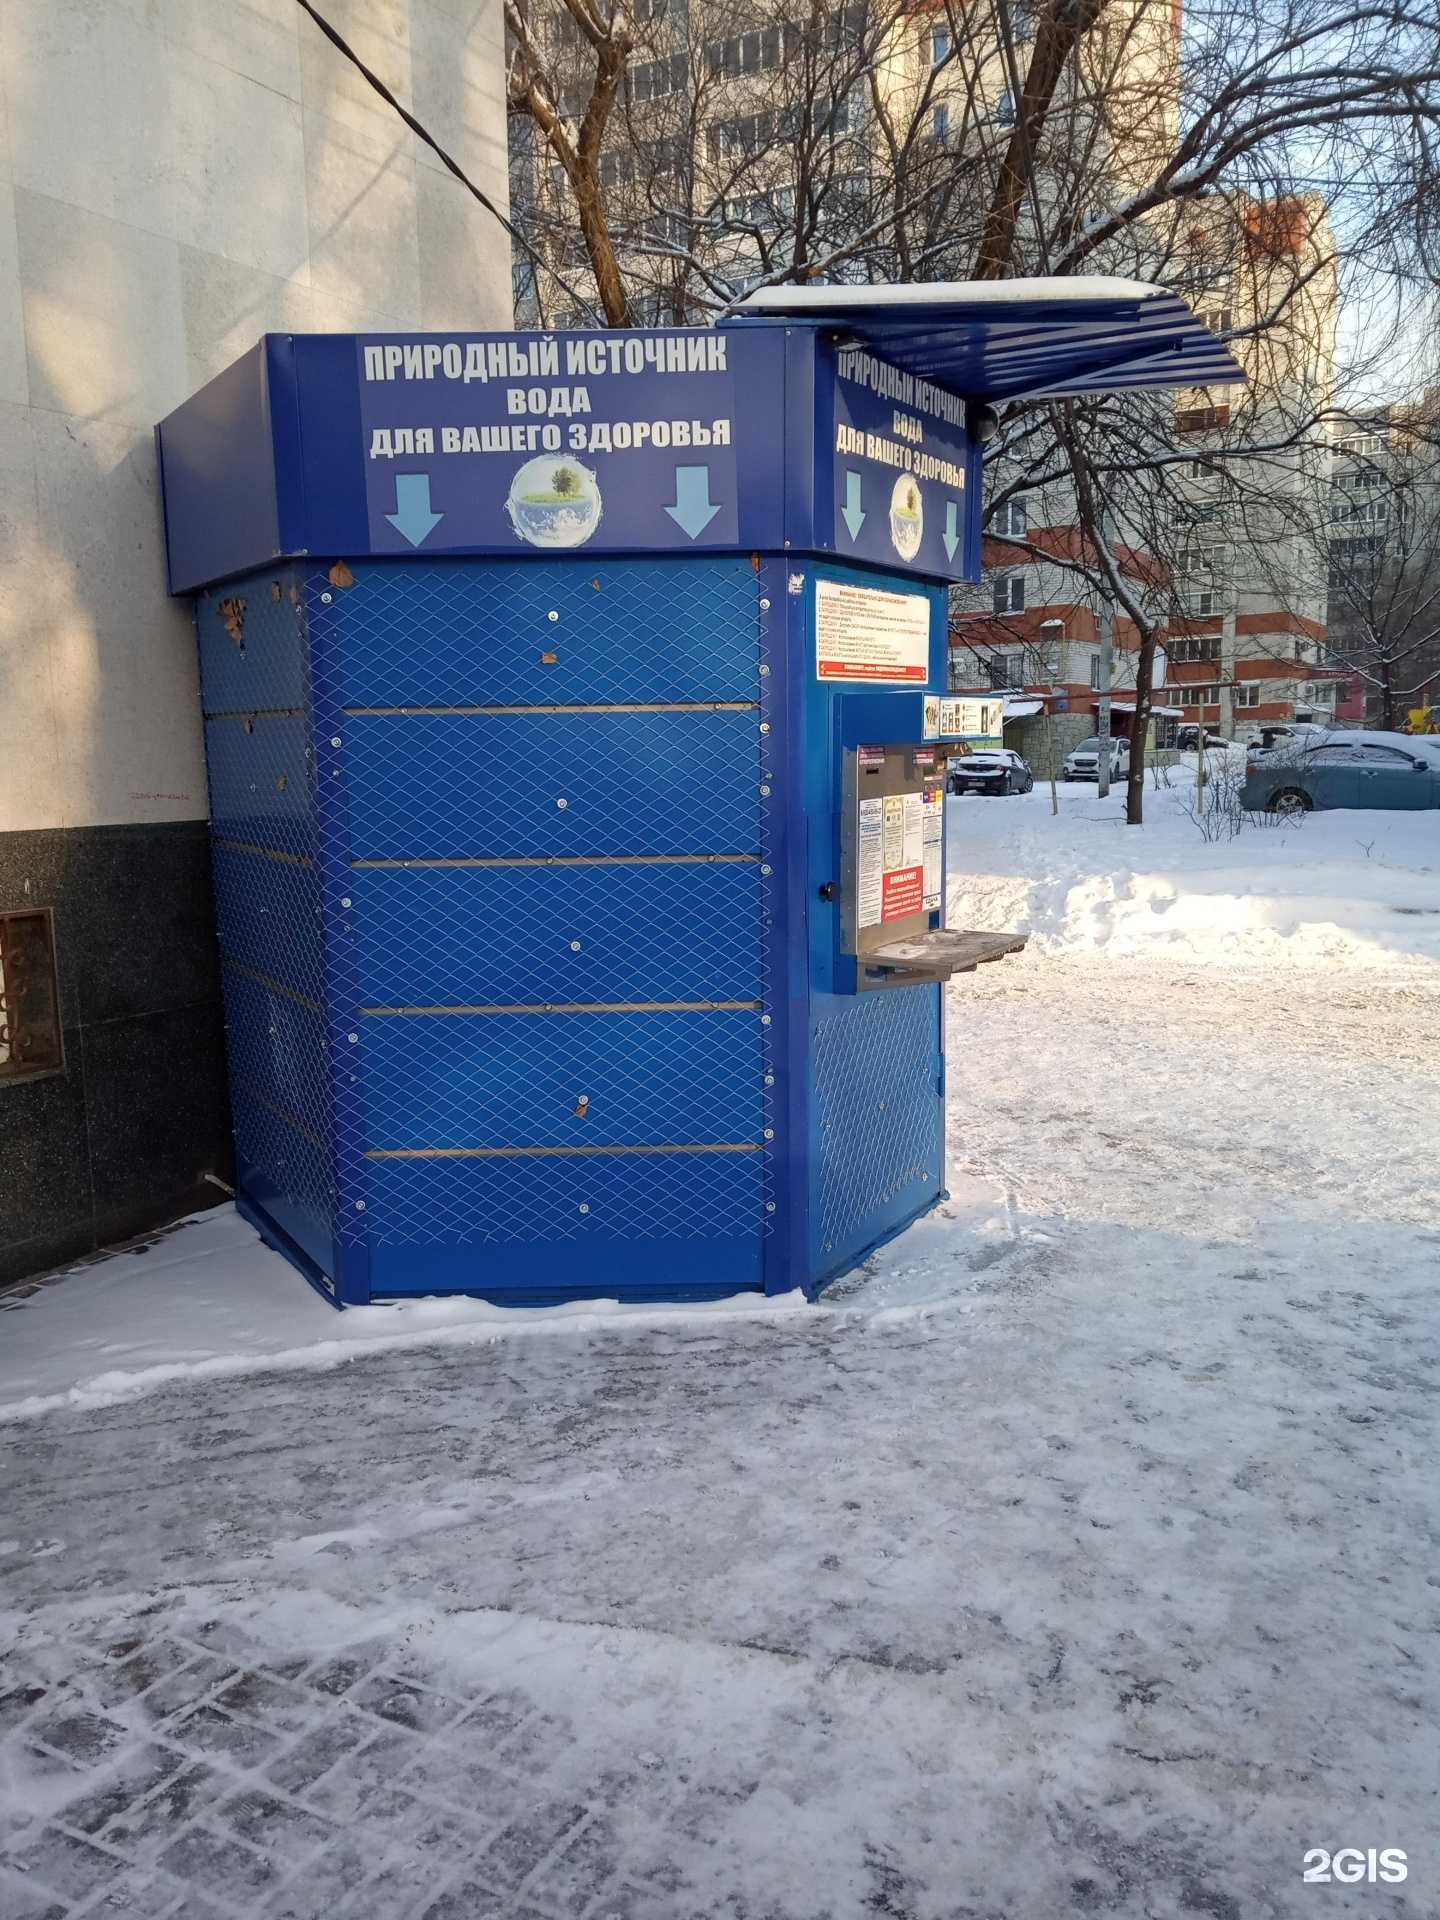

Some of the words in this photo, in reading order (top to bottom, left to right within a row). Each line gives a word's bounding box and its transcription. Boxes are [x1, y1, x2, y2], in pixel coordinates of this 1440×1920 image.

[364, 335, 559, 384] ПРИРОДНЫЙ
[566, 335, 728, 376] ИСТОЧНИК
[506, 386, 592, 418] ВОДА
[915, 377, 966, 429] ИСТОЧНИК
[370, 427, 435, 459] ДЛЯ
[442, 424, 562, 454] ВАШЕГО
[568, 419, 731, 454] ЗДОРОВЬЯ
[893, 409, 923, 444] ВОДА
[836, 423, 864, 456] ДЛЯ
[866, 433, 912, 471] ВАШЕГО
[913, 451, 966, 489] ЗДОРОВЬЯ
